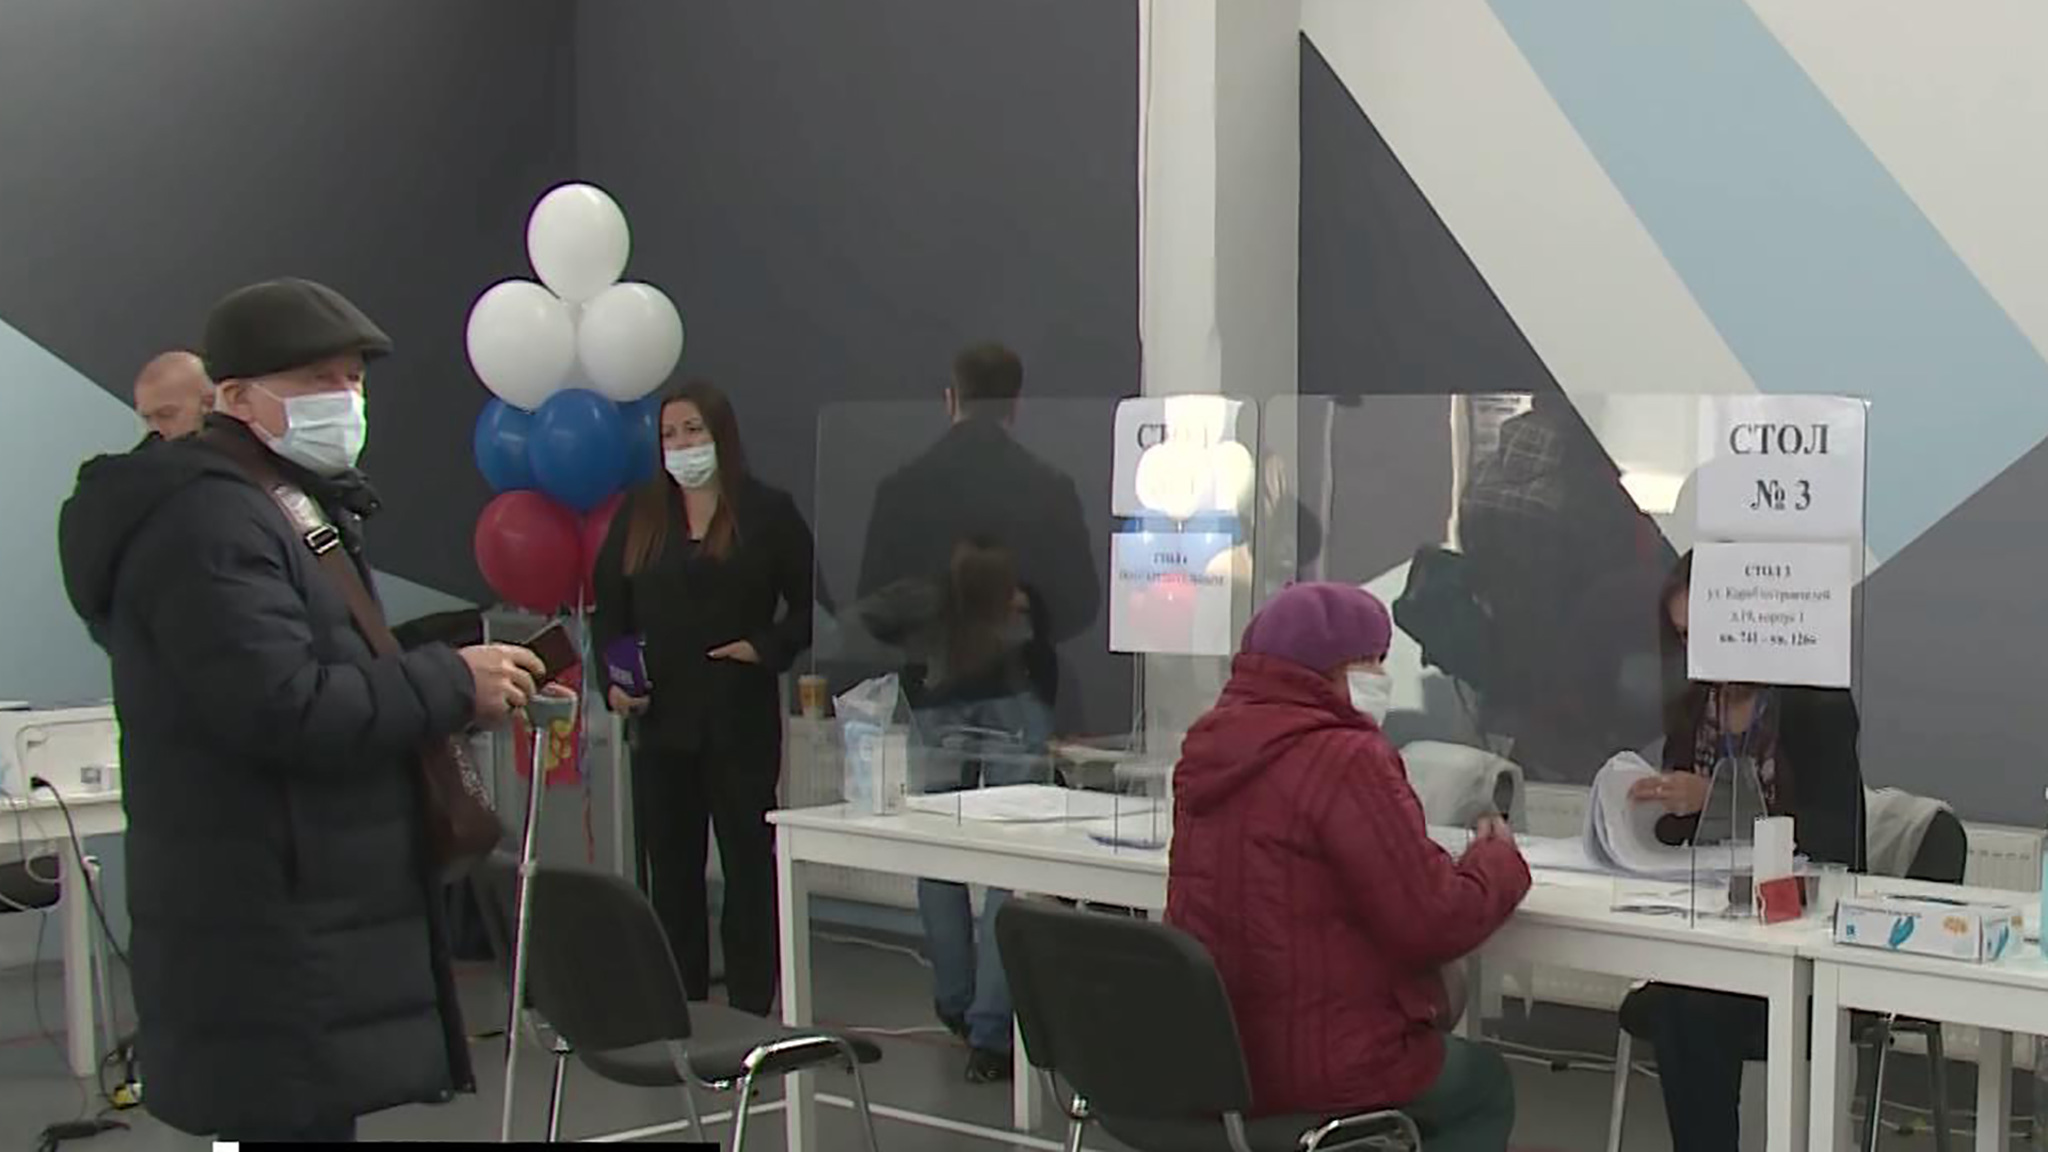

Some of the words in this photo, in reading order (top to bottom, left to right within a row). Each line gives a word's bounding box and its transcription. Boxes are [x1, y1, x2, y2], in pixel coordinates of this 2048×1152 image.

[1729, 424, 1828, 455] СТОЛ
[1751, 479, 1785, 510] №
[1795, 479, 1811, 510] 3
